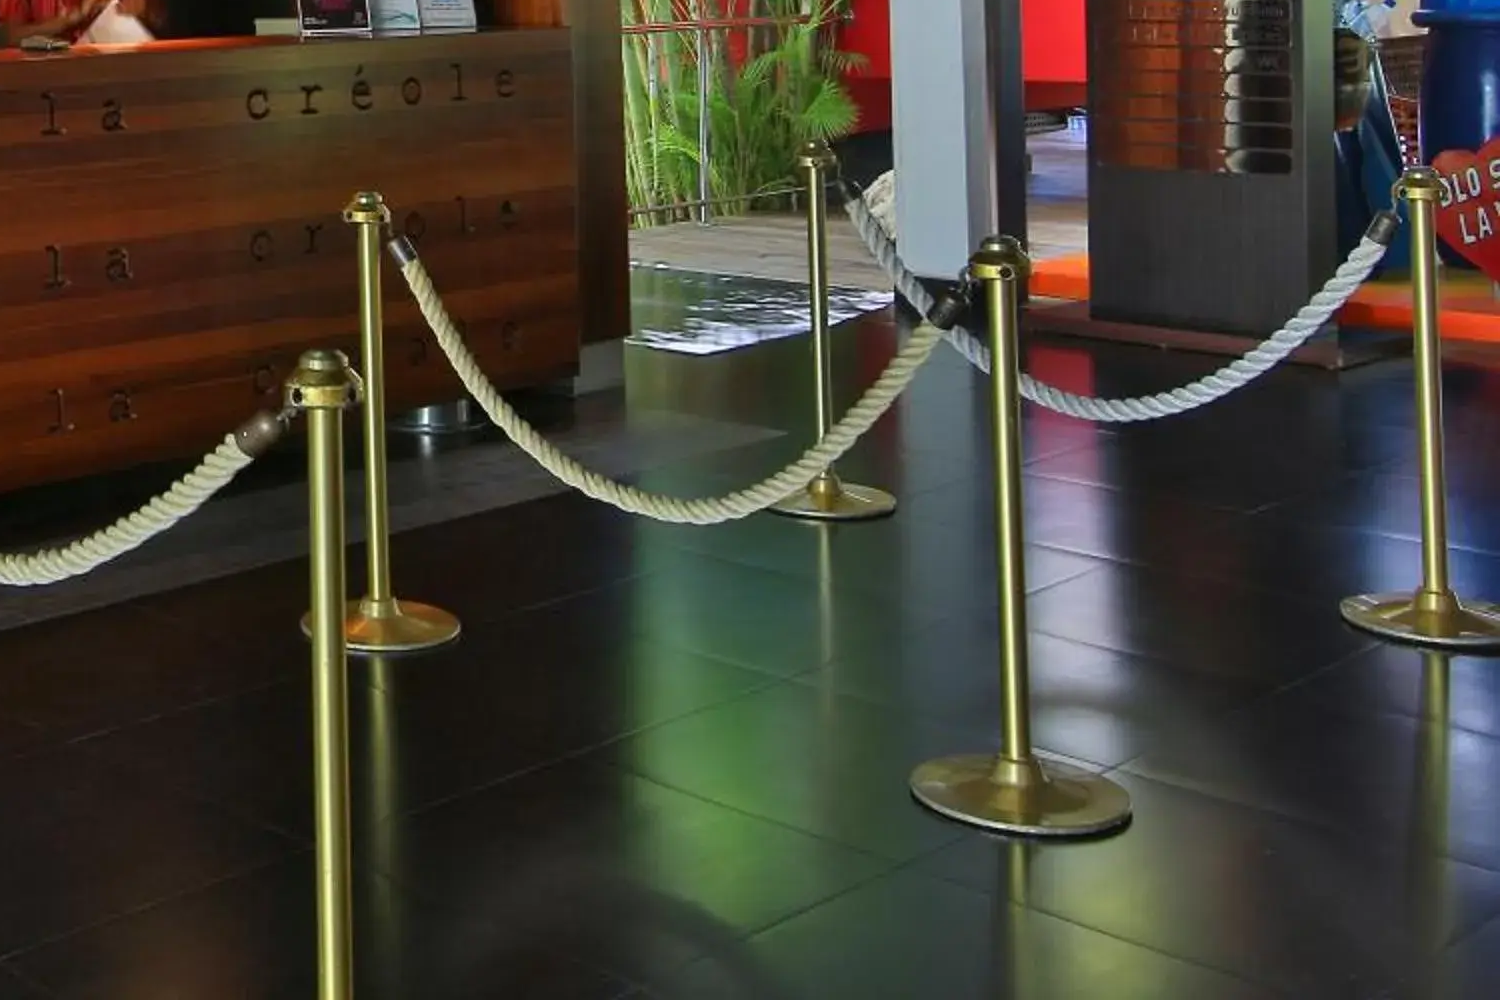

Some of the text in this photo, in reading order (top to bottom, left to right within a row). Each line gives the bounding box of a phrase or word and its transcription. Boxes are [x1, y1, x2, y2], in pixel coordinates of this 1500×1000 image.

[39, 91, 129, 137] la
[246, 62, 517, 120] créole
[43, 243, 134, 290] la
[250, 195, 521, 263] crole
[48, 387, 138, 434] la
